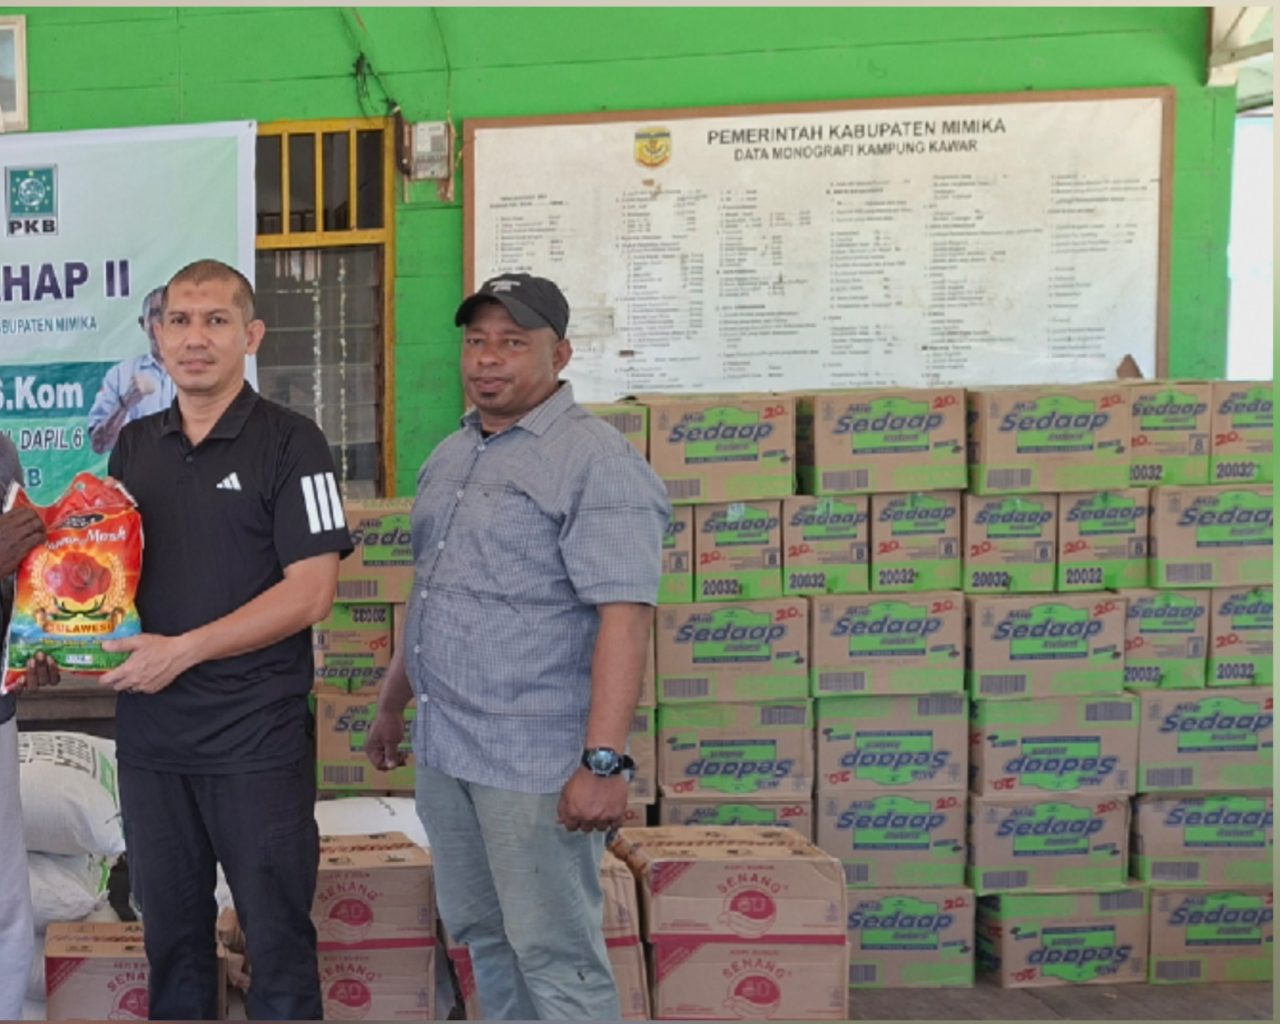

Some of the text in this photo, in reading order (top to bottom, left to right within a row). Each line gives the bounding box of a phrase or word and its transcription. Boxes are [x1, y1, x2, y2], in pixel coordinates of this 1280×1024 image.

[707, 118, 1006, 145] PEMERINTAH KABUPATEN MIMIKA
[734, 139, 979, 162] DATA MONOGRAFI KAMPUNG KAWAR
[8, 219, 55, 234] PKB
[105, 259, 129, 297] II
[56, 316, 97, 331] MIMIKA
[1132, 403, 1207, 416] Sedaap
[834, 412, 943, 434] Sedaap
[999, 411, 1109, 431] Sedaap
[21, 428, 83, 449] DAPIL 6
[668, 422, 773, 443] Sedaap
[1217, 462, 1255, 478] 20032
[789, 573, 825, 589] 20032
[879, 569, 914, 584] 20032
[972, 572, 1008, 587] 20032
[1066, 568, 1102, 584] 20032
[703, 579, 738, 595] 20032
[1128, 604, 1205, 618] Sedaap
[674, 622, 786, 644] Sedaap
[831, 615, 941, 636] Sedaap
[993, 618, 1102, 639] Sedaap
[1217, 663, 1254, 679] 20032
[685, 759, 794, 778] Sedaap
[841, 750, 949, 769] Sedaap
[1005, 755, 1118, 775] Sedaap
[836, 811, 946, 830] Sedaap
[995, 817, 1105, 837] Sedaap
[847, 910, 953, 933] Sedaap
[1027, 945, 1132, 966] Sedaap
